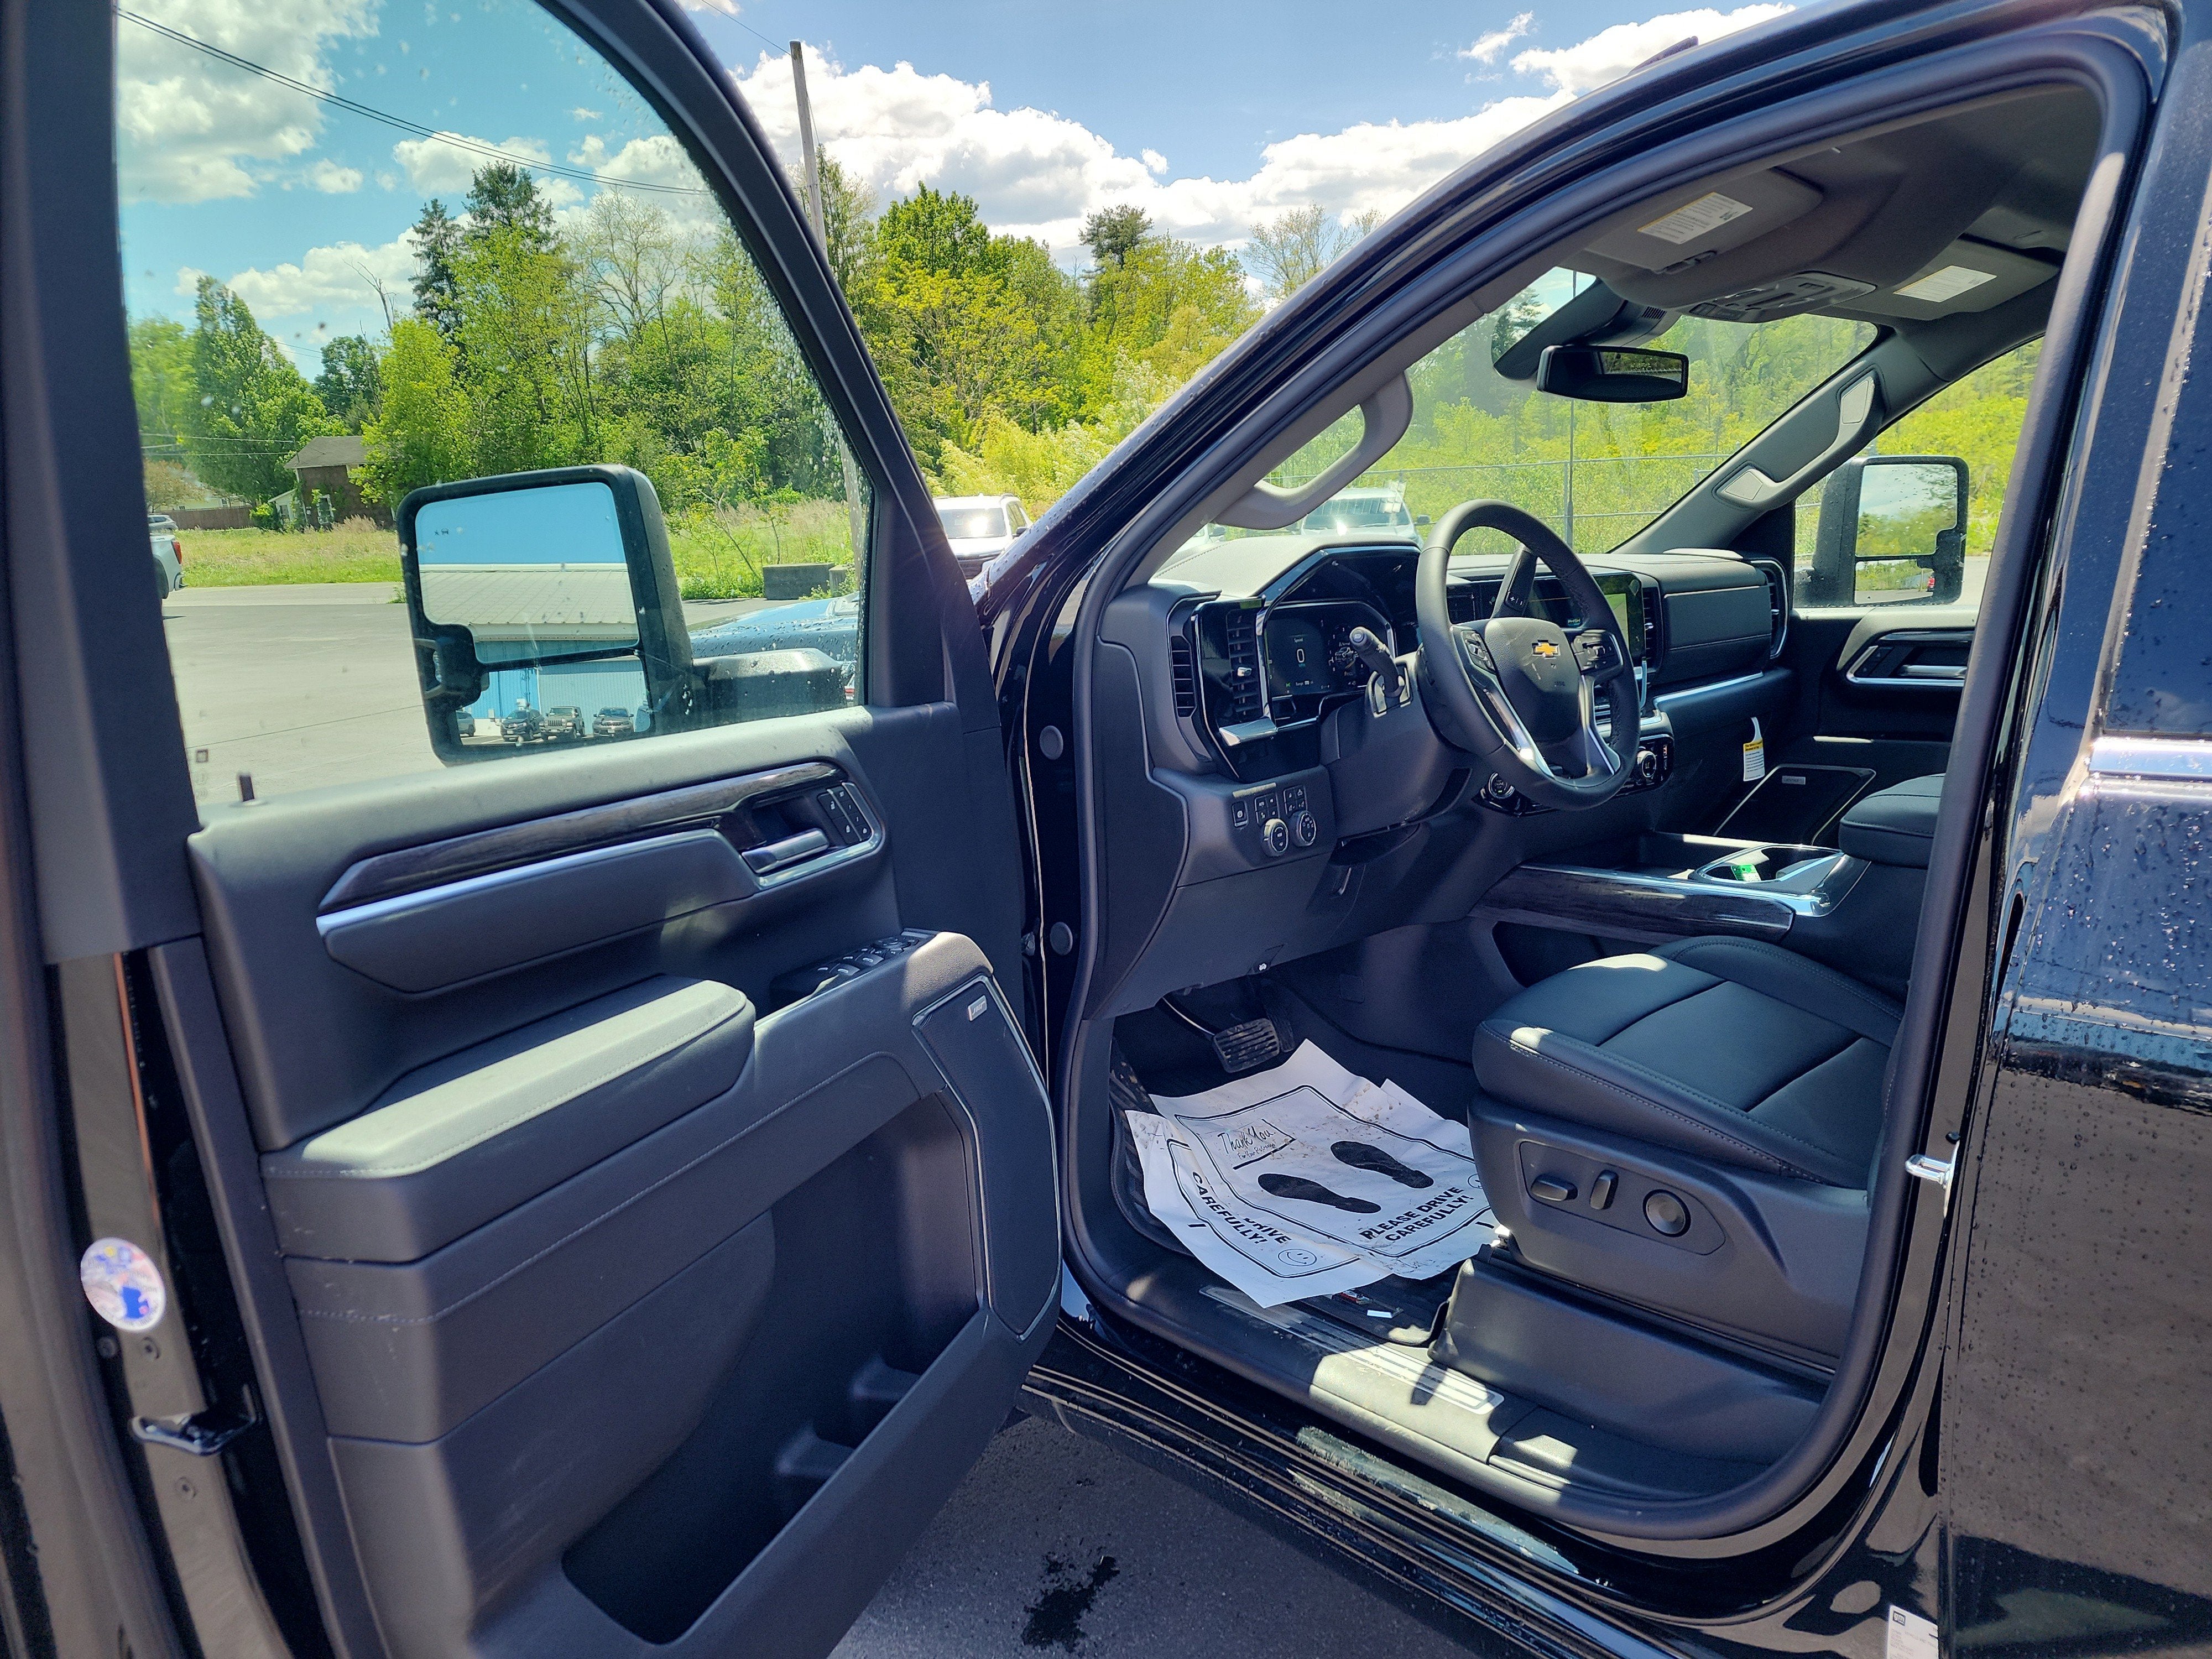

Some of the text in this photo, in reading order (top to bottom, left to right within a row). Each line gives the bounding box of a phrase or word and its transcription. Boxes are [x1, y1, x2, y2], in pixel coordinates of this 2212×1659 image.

[1296, 648, 1305, 663] 0
[1217, 1125, 1274, 1154] Thank You
[1192, 1171, 1268, 1244] CAREFULLY!
[1359, 1187, 1464, 1240] PLEASE DRIVE
[1385, 1194, 1474, 1241] CAREFULLY!
